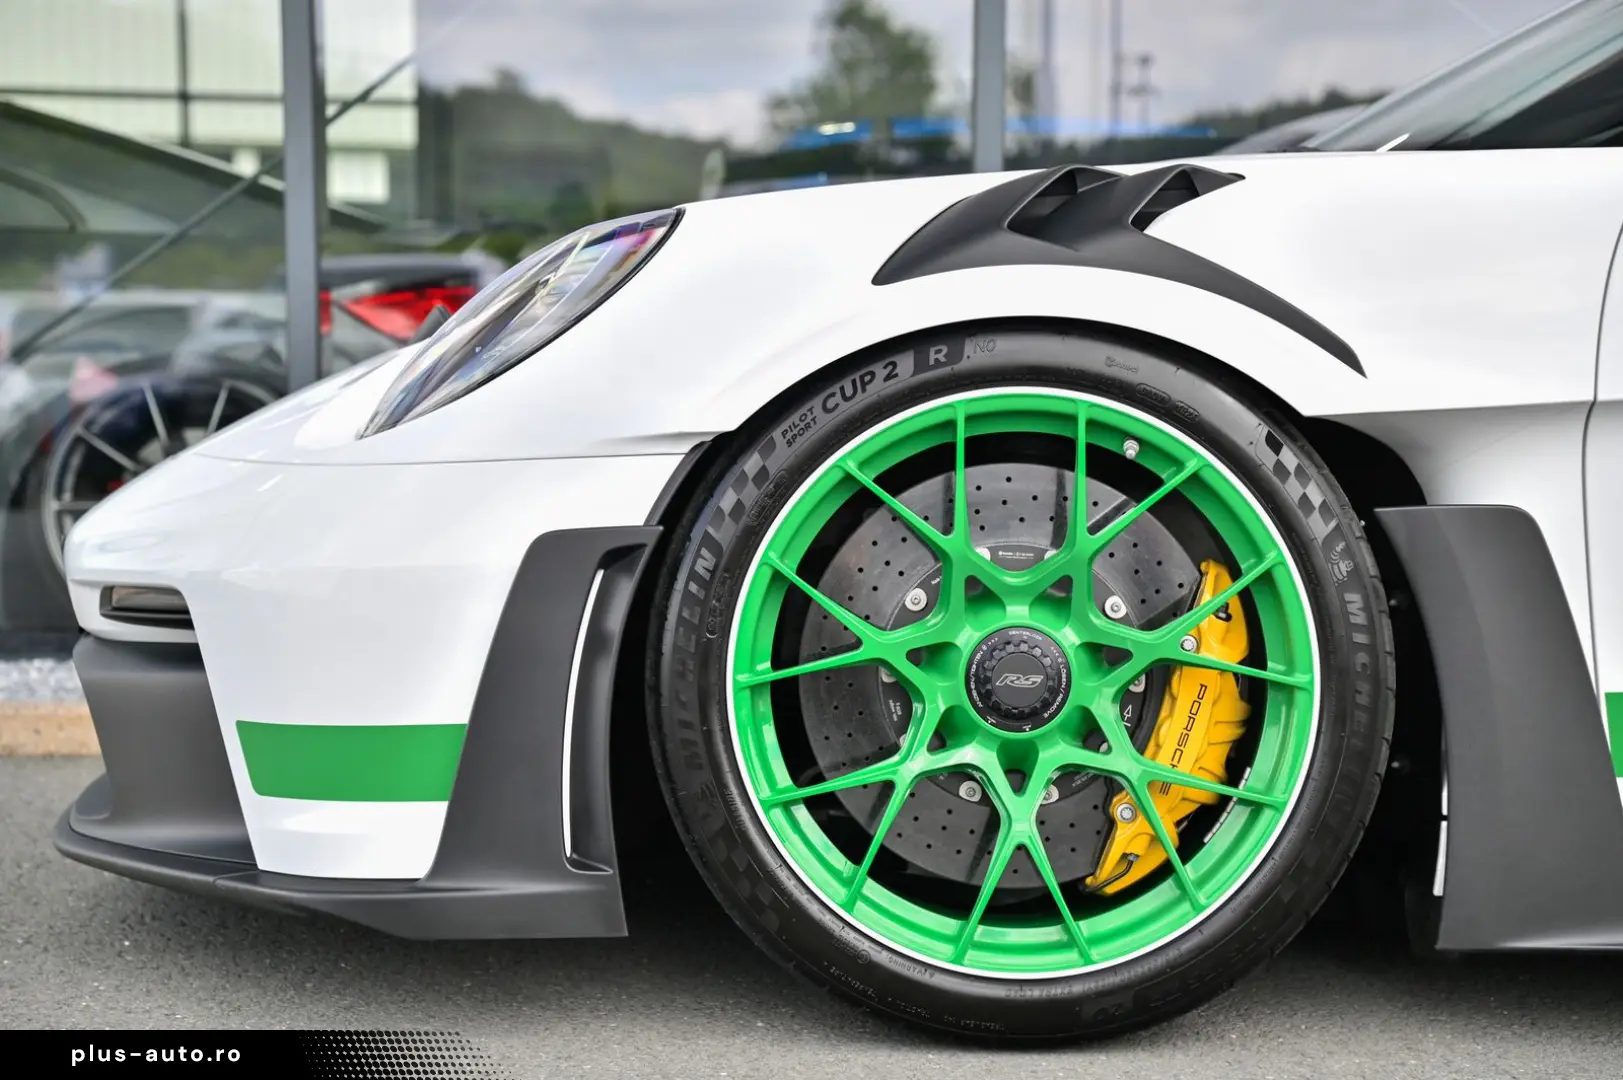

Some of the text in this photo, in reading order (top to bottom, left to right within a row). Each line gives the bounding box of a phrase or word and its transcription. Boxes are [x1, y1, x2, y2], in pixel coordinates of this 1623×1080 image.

[821, 344, 948, 414] CUP 2 R
[781, 405, 815, 439] PILOT
[786, 416, 818, 448] SPORT
[996, 673, 1044, 688] RS
[1043, 693, 1064, 719] REMOVE
